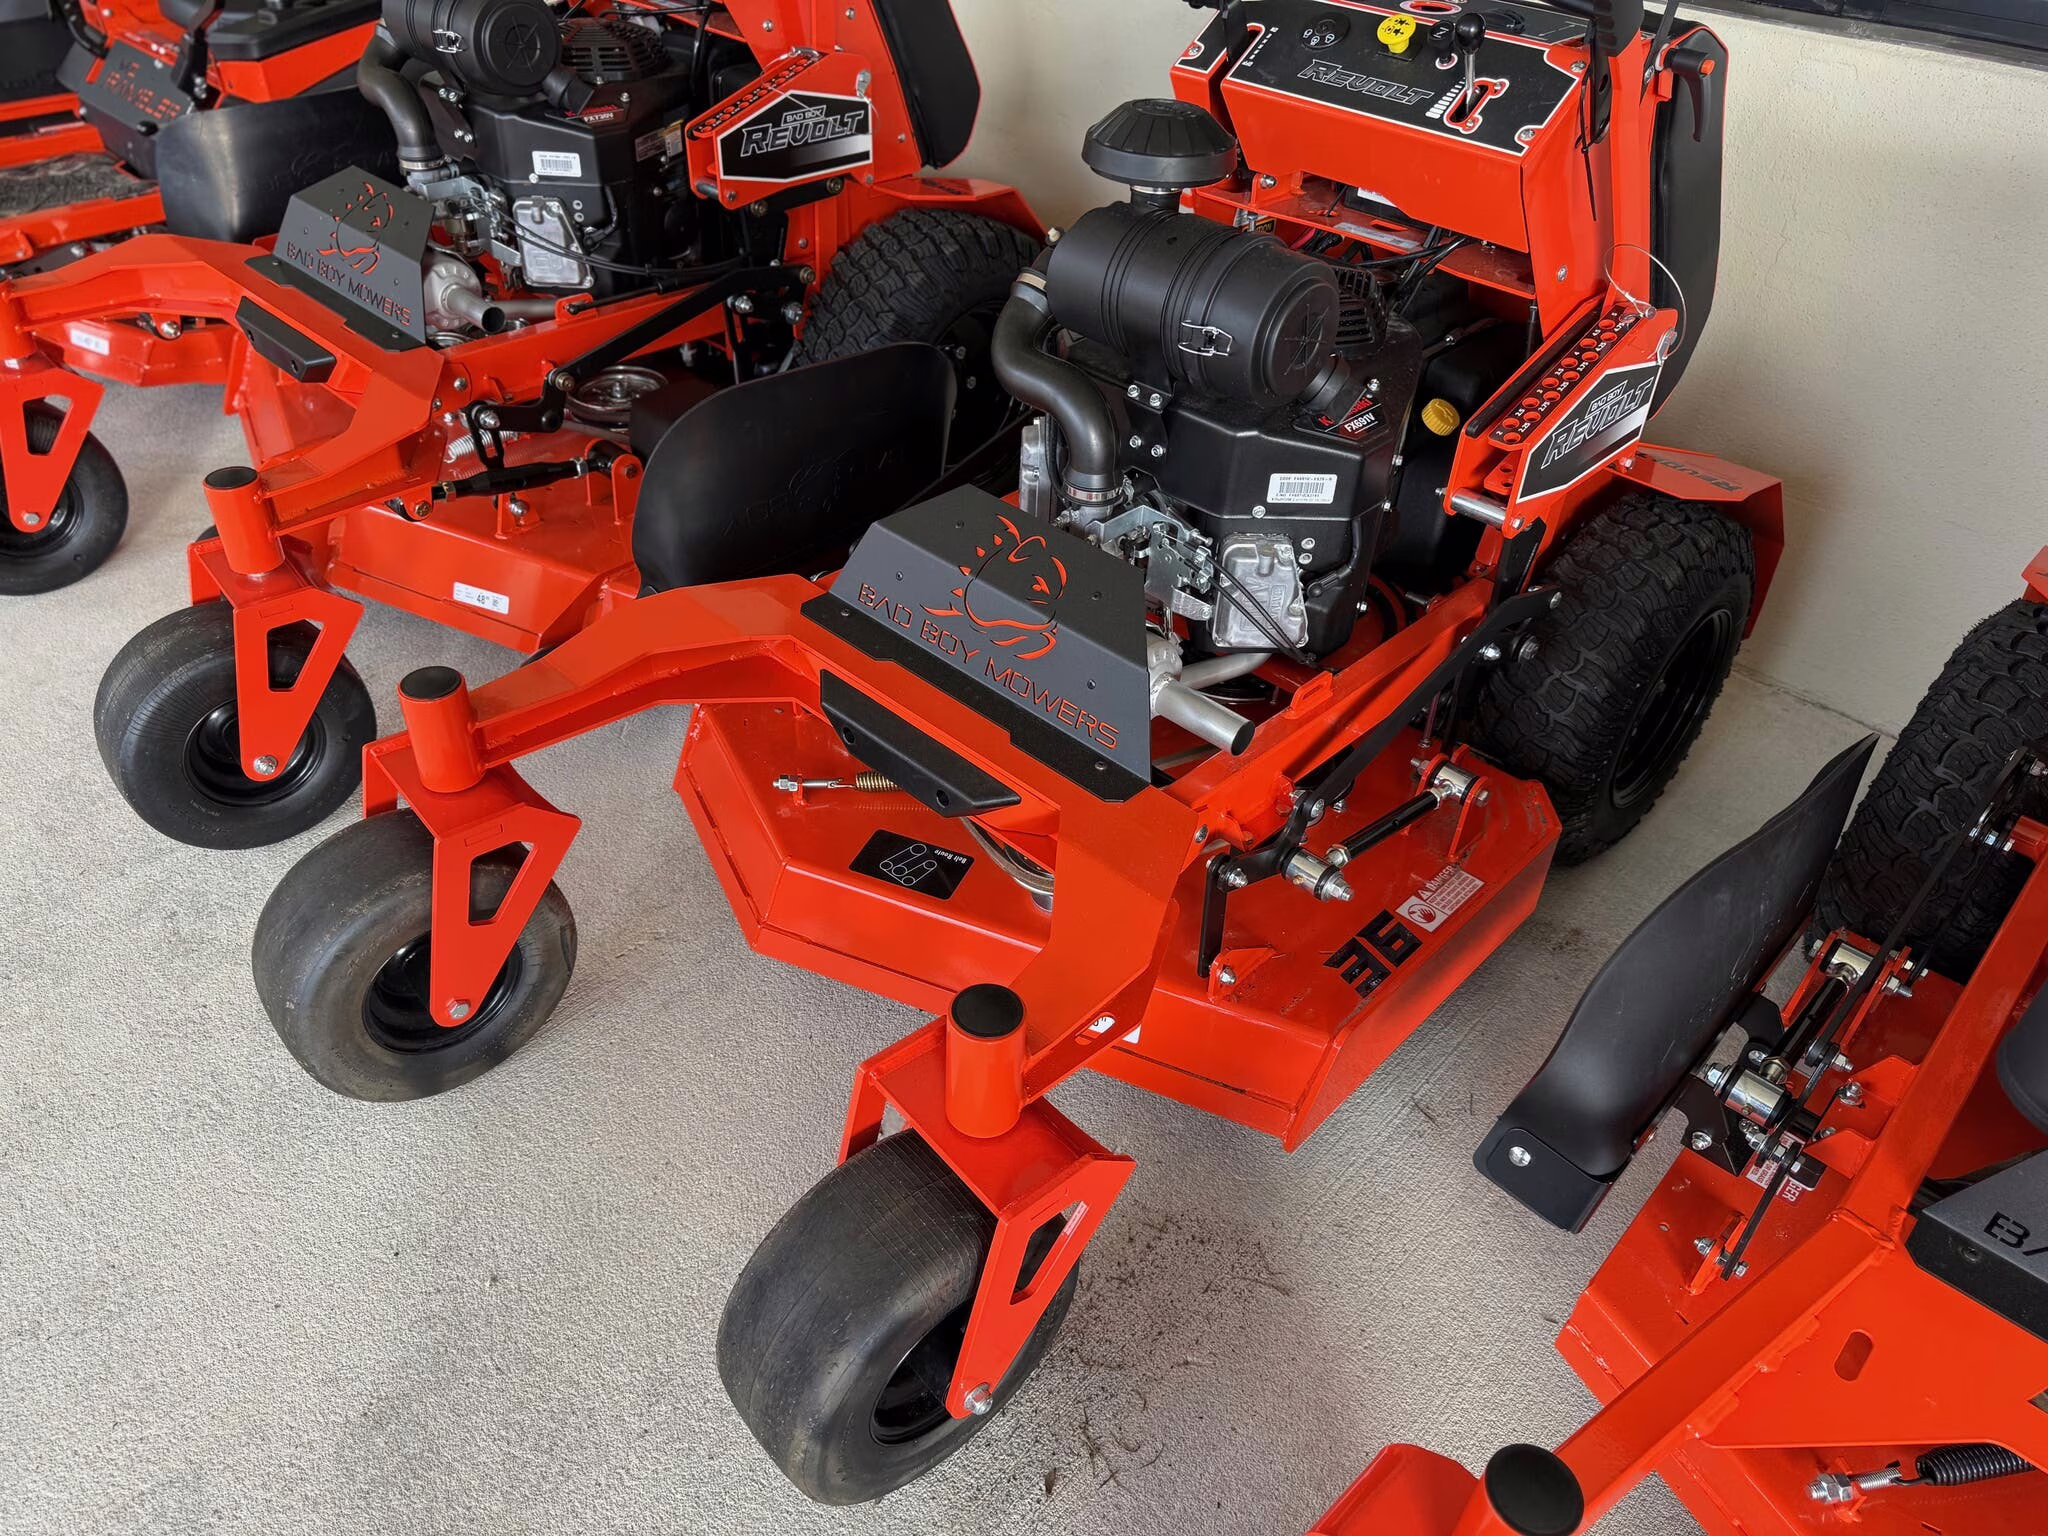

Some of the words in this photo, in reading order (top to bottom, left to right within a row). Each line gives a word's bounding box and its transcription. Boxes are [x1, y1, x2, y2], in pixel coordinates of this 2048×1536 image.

[1297, 58, 1434, 105] REVOLT
[786, 112, 804, 122] BAD
[740, 110, 864, 157] REVOLT
[287, 241, 314, 269] BAD
[317, 258, 346, 286] BOY
[348, 277, 411, 327] MOWERS
[1591, 396, 1607, 411] BAD
[1607, 389, 1622, 402] BOY
[1344, 412, 1376, 432] FX691V
[1540, 376, 1655, 470] REVOLT
[857, 583, 913, 631] BAD
[919, 620, 979, 664] BOY
[985, 656, 1119, 750] MOWERS
[934, 849, 954, 860] Route
[953, 855, 967, 864] Belt
[1429, 864, 1458, 894] DANGER
[1323, 909, 1423, 999] 36
[1781, 1181, 1803, 1202] GER
